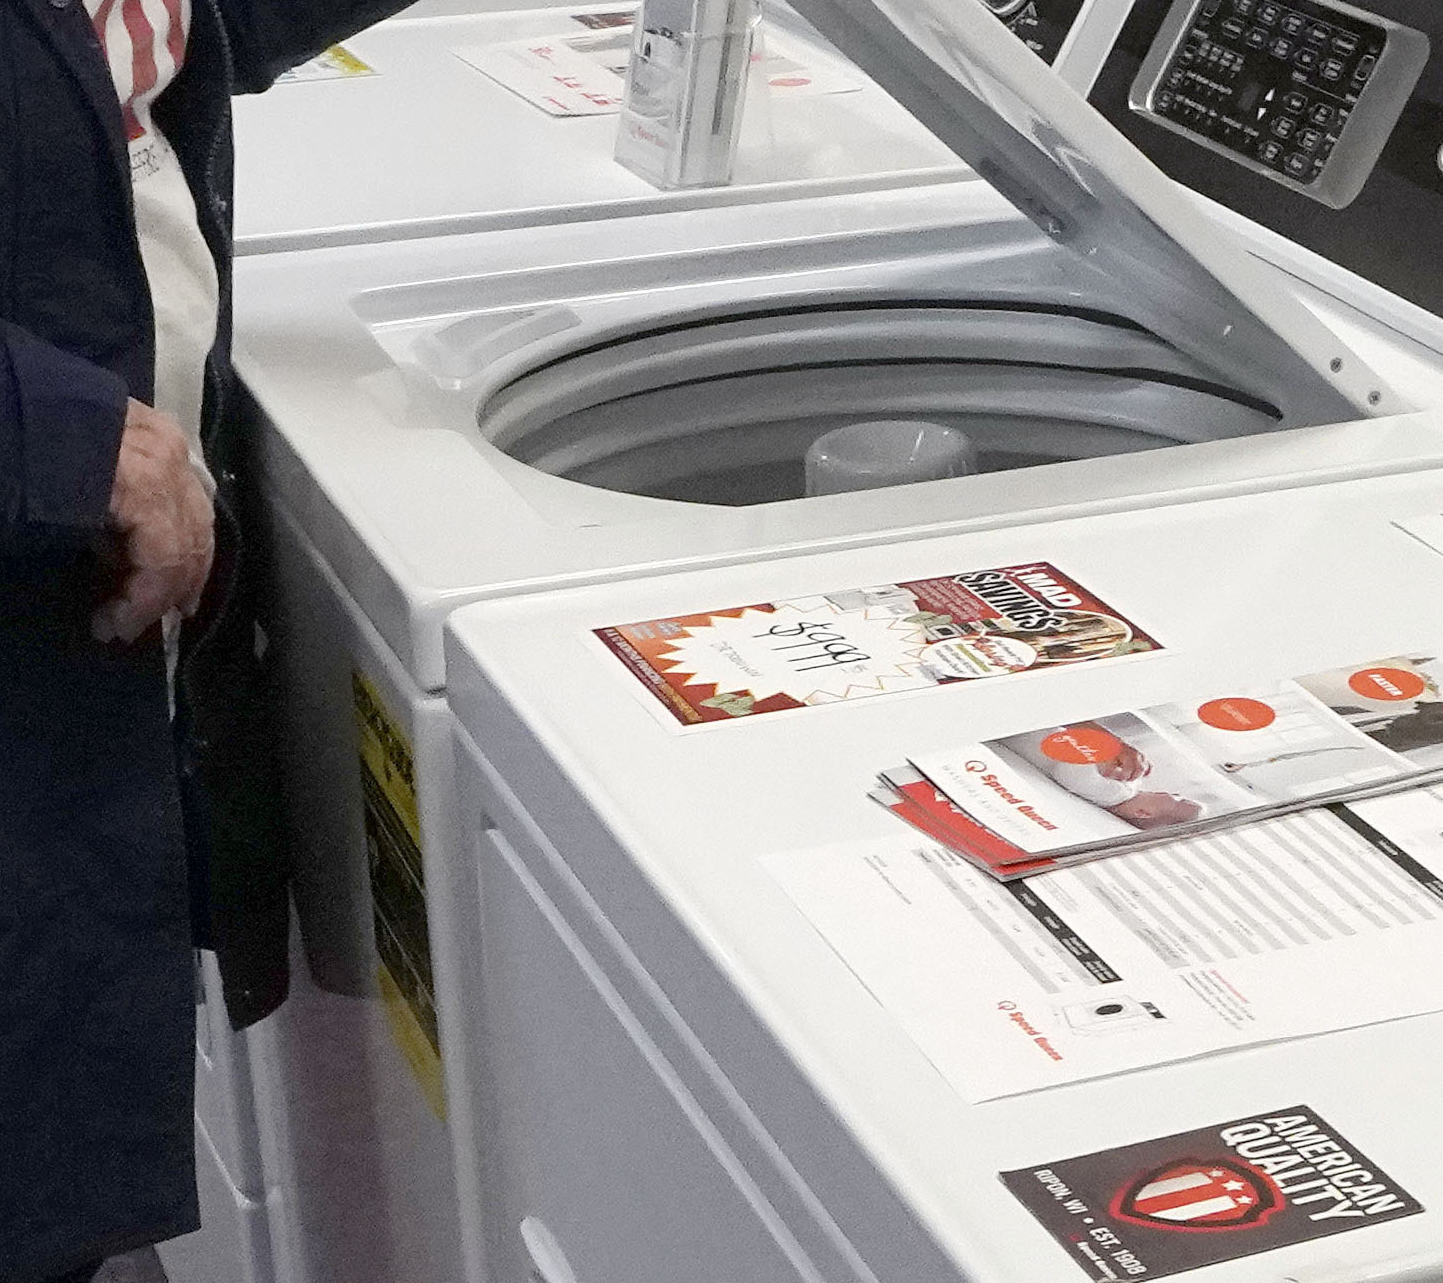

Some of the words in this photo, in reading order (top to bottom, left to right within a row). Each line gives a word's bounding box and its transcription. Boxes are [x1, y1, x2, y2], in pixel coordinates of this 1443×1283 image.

[1015, 571, 1087, 609] MAD
[973, 773, 1030, 805] Speed
[1014, 804, 1061, 831] Queen
[1220, 1122, 1369, 1222] QUALITY
[1263, 1115, 1405, 1214] AMERICAN
[1087, 1226, 1123, 1249] EST.
[1109, 1248, 1149, 1276] 1908
